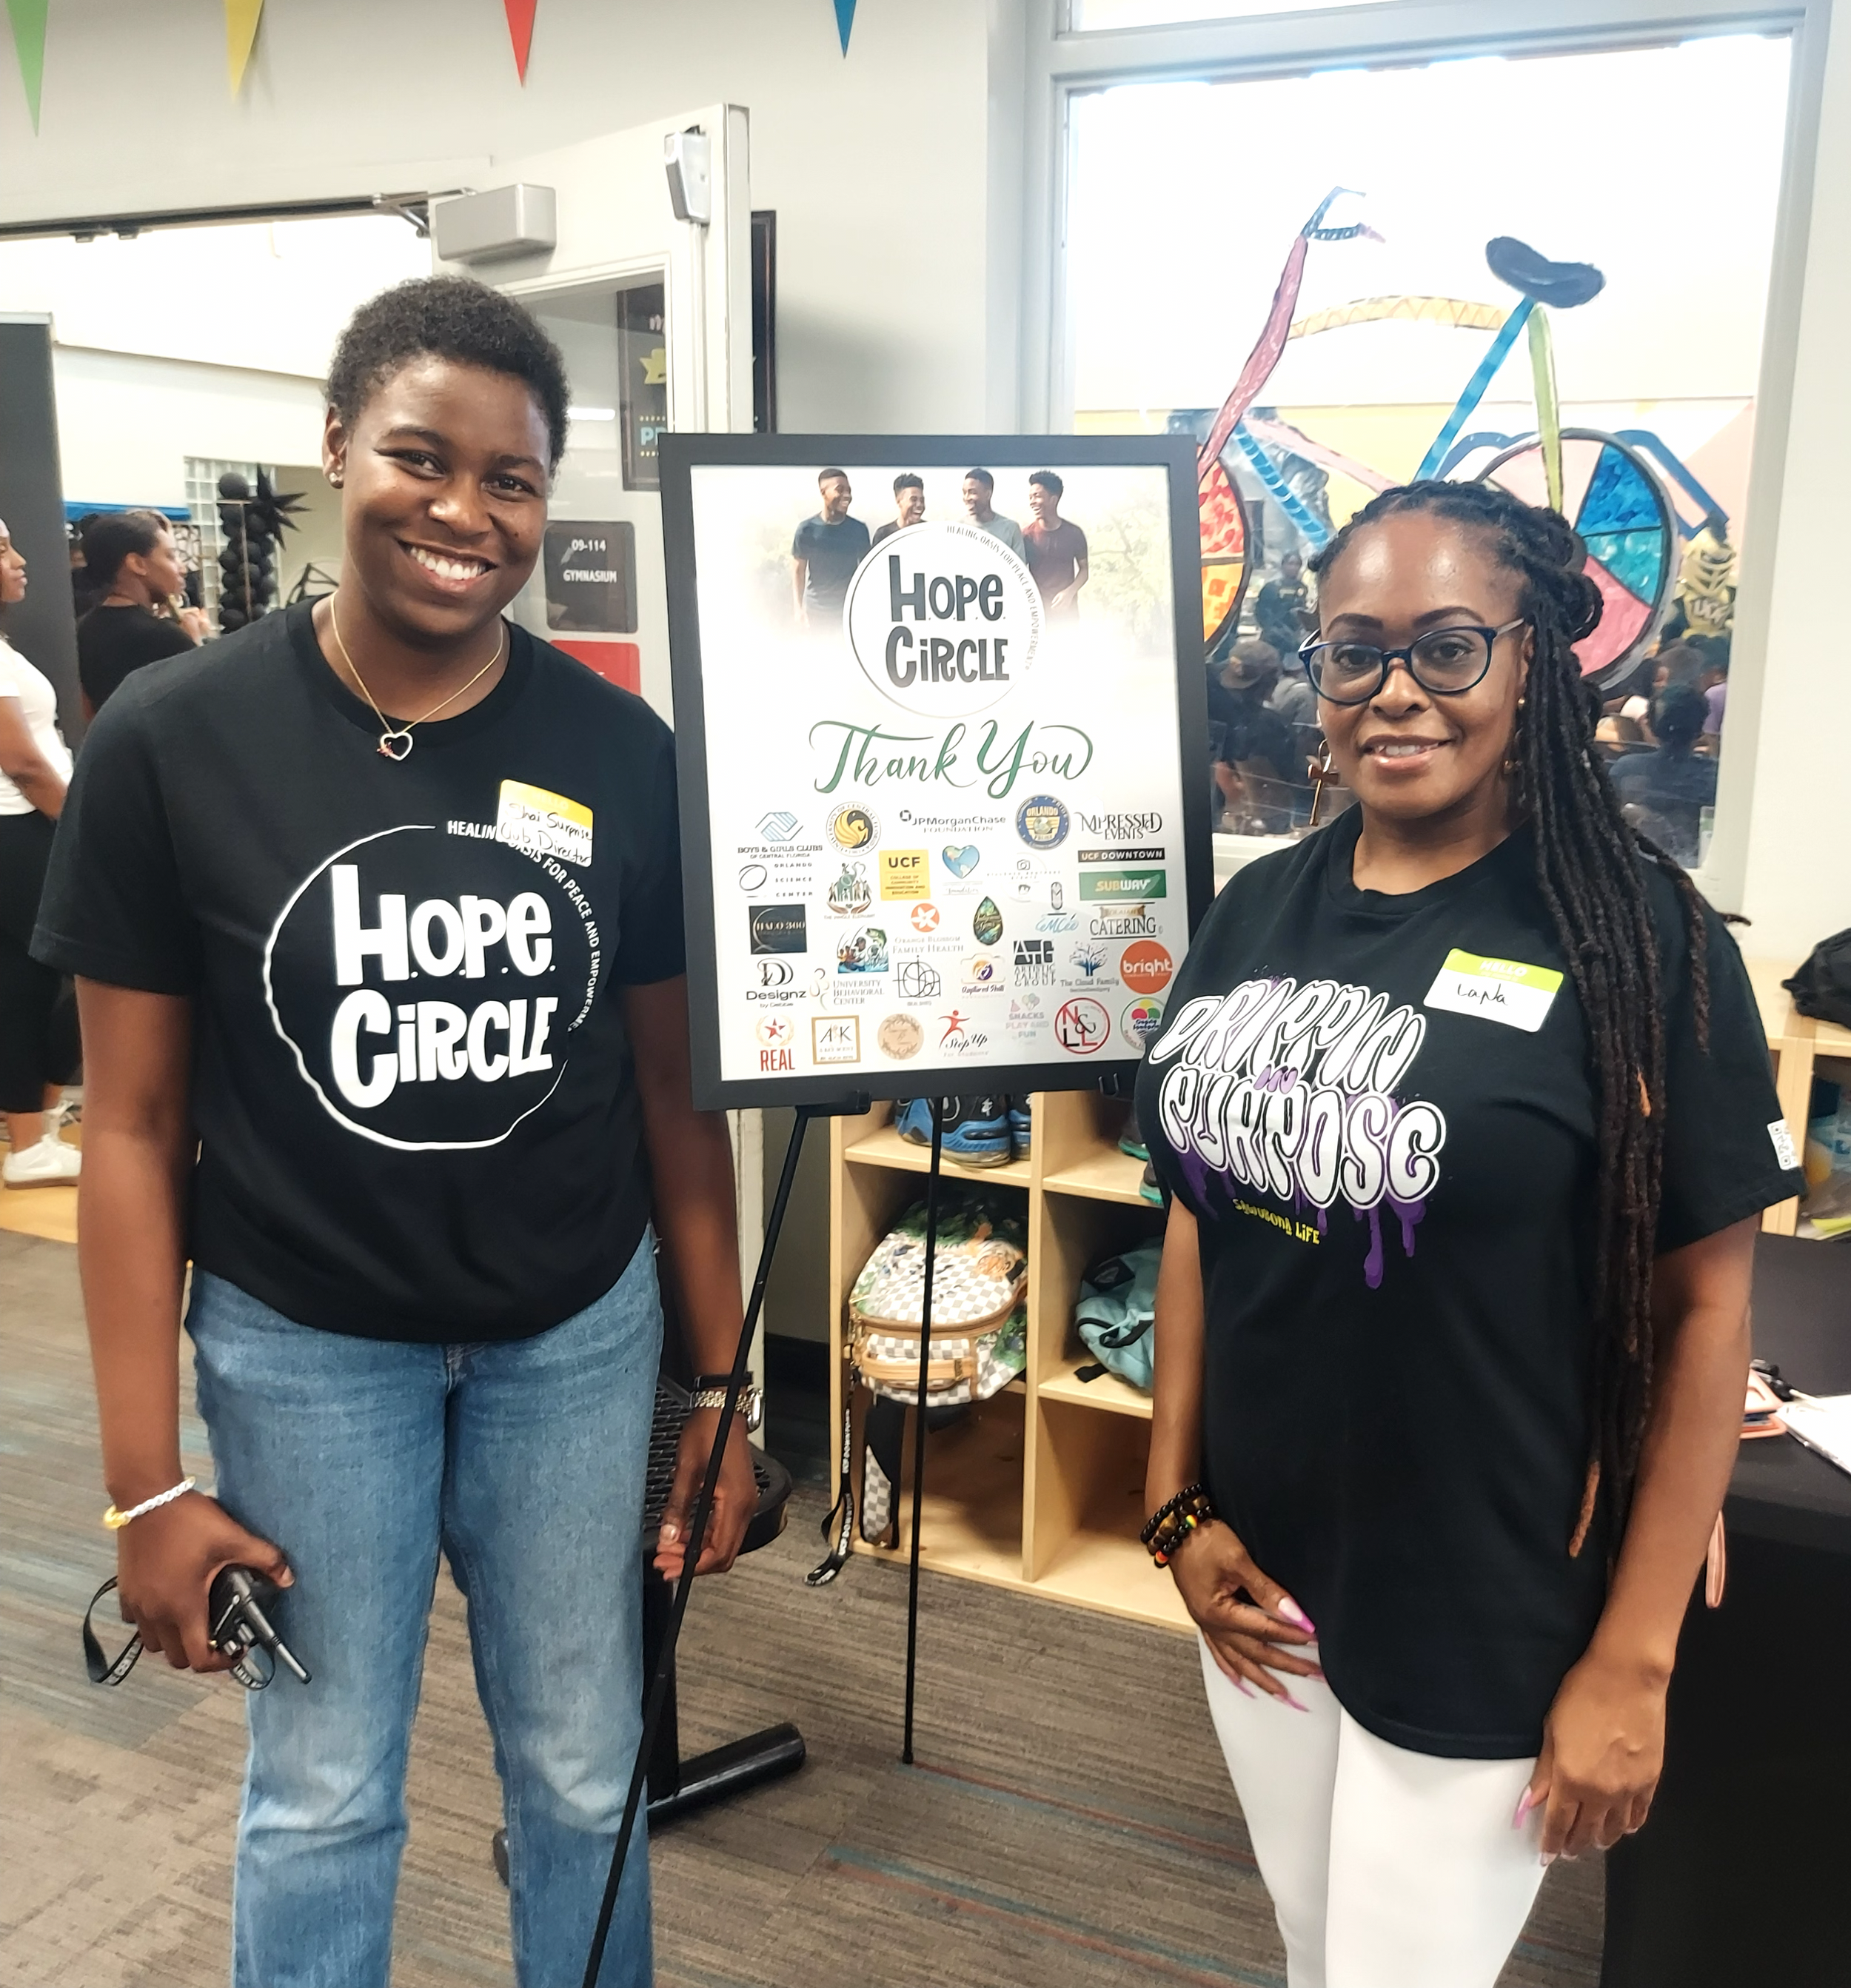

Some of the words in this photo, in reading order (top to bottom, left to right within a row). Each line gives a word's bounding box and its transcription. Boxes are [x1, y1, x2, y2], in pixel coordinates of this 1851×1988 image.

[572, 538, 606, 552] 09-114
[980, 535, 1000, 554] OASIS
[563, 569, 617, 583] GYMNASIUM
[809, 720, 978, 794] Thank
[977, 719, 1094, 799] You
[1026, 806, 1059, 817] ORLANDO
[546, 812, 593, 841] Surprise
[911, 816, 1007, 826] JPMorganChase
[1105, 828, 1145, 840] EVENTS
[1081, 852, 1099, 860] UCF
[1101, 850, 1163, 860] DOWNTOWN
[888, 857, 921, 869] UCF
[446, 820, 497, 840] HEALIN
[542, 857, 568, 883] FOR
[563, 878, 593, 920] PEACE
[584, 920, 600, 948] AND
[1095, 878, 1152, 892] SUBWAY
[1089, 916, 1157, 936] CATERING
[892, 946, 924, 954] FAMILY
[928, 944, 964, 953] HEALTH
[1122, 957, 1173, 977] bright
[1479, 960, 1528, 977] HELLO
[833, 980, 881, 988] UNIVERSITY
[746, 990, 807, 1001] Designz
[833, 988, 885, 997] BEHAVIORAL
[833, 997, 866, 1005] CENTER
[945, 1037, 970, 1054] Step
[971, 1033, 988, 1048] Up
[760, 1048, 796, 1071] REAL
